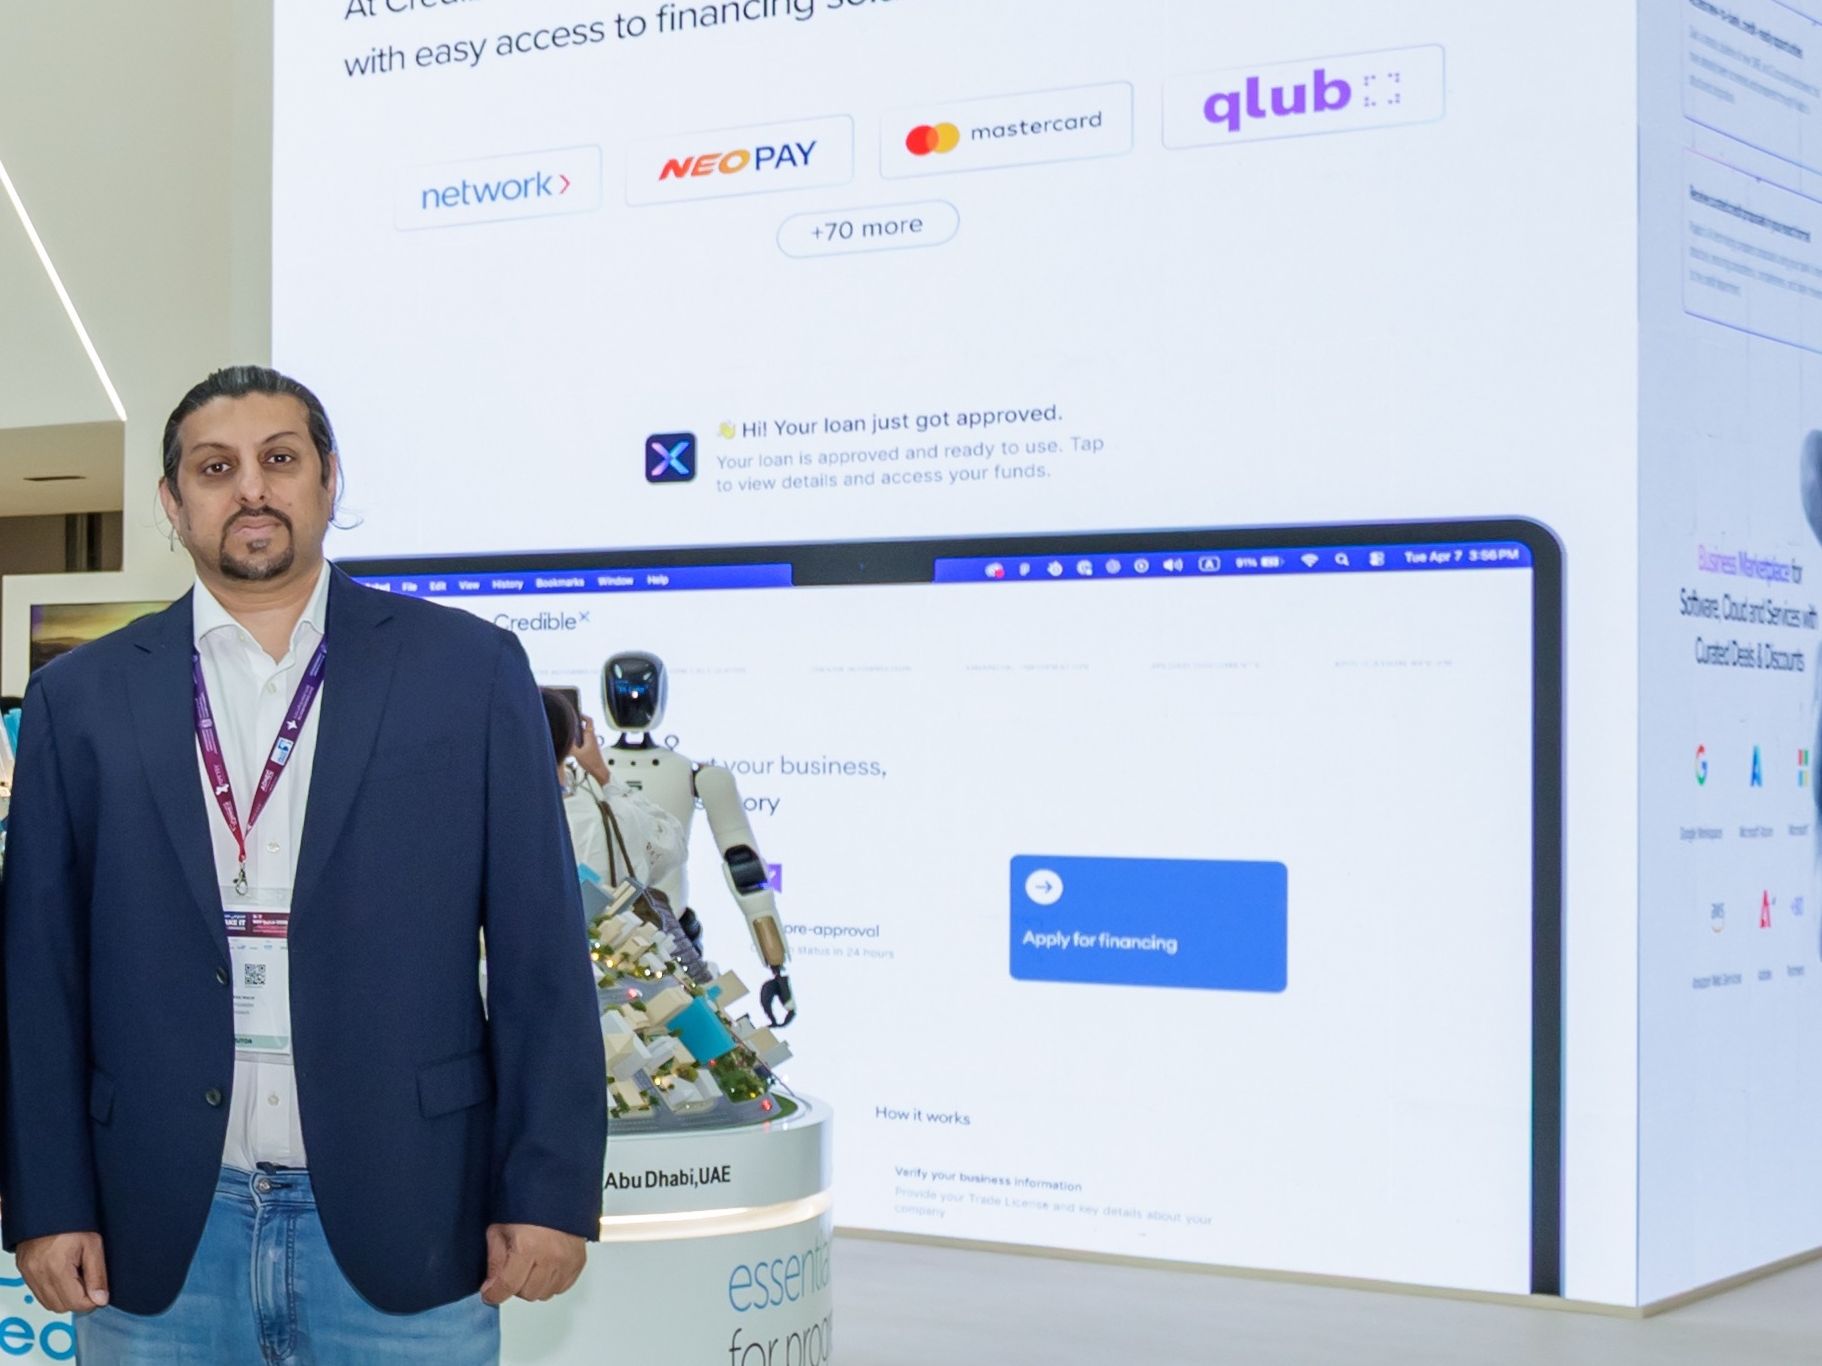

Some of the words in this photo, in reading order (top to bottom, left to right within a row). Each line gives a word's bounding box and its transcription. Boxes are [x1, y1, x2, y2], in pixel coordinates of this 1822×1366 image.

[344, 44, 406, 78] with
[414, 37, 486, 67] easy
[495, 18, 605, 57] access
[614, 11, 647, 40] to
[1203, 68, 1353, 132] qlub
[971, 111, 1103, 142] mastercard
[421, 171, 553, 211] network
[811, 220, 853, 241] +70
[861, 215, 924, 237] more
[742, 421, 768, 439] Hi!
[774, 419, 817, 438] Your
[824, 415, 867, 434] loan
[871, 413, 909, 434] just
[916, 410, 951, 432] got
[957, 404, 1064, 432] approved.
[717, 454, 753, 471] Your
[758, 451, 795, 468] loan
[798, 450, 813, 466] is
[818, 445, 899, 469] approved
[904, 443, 938, 461] and
[944, 440, 995, 464] ready
[1000, 440, 1019, 456] to
[1026, 439, 1064, 456] use.
[1070, 436, 1105, 456] Tap
[716, 477, 733, 493] to
[738, 475, 776, 492] view
[782, 471, 838, 490] details
[843, 470, 876, 487] and
[881, 469, 943, 486] access
[949, 465, 989, 486] your
[994, 462, 1052, 481] funds.
[781, 755, 887, 778] business,
[1023, 930, 1070, 950] Apply
[1074, 931, 1096, 949] for
[1099, 932, 1178, 955] financing
[876, 1106, 910, 1122] How
[913, 1107, 922, 1123] it
[926, 1109, 970, 1126] works
[604, 1170, 642, 1190] Abu
[895, 1166, 927, 1181] Verify
[931, 1171, 956, 1183] your
[960, 1172, 1011, 1187] business
[1015, 1176, 1083, 1192] information
